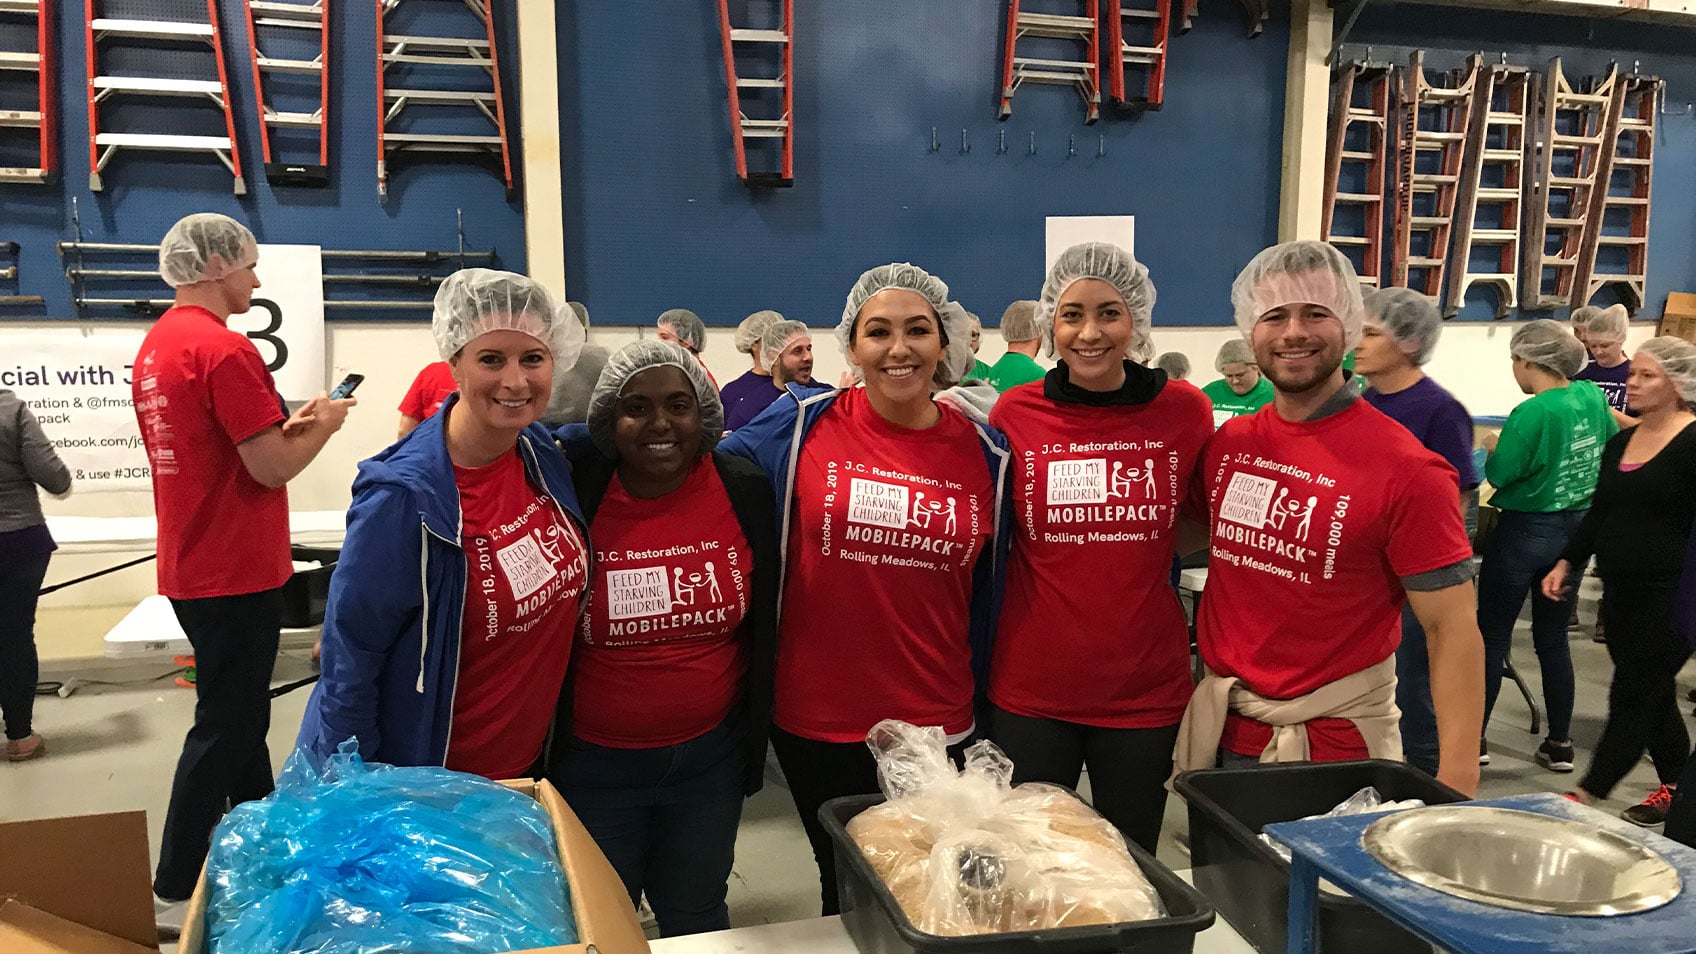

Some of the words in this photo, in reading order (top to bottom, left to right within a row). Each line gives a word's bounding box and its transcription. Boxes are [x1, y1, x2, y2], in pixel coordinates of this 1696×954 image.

[246, 297, 289, 372] 3
[57, 365, 115, 385] with
[73, 397, 83, 408] &
[38, 412, 71, 424] pack
[1041, 443, 1066, 455] J.C.
[1069, 440, 1141, 453] Restoration,
[1145, 440, 1164, 449] Inc
[76, 469, 85, 480] &
[89, 470, 110, 480] use
[114, 467, 150, 479] #JCR
[827, 460, 838, 488] 2019
[1025, 450, 1035, 477] 2019
[1053, 463, 1081, 477] FEED
[1086, 462, 1100, 474] MY
[1216, 454, 1230, 482] 2019
[1234, 452, 1250, 465] J.C.
[1253, 456, 1314, 483] Restoration,
[1316, 473, 1336, 488] Inc
[844, 461, 869, 473] J.C.
[872, 467, 943, 488] Restoration,
[945, 479, 963, 490] Inc
[1053, 475, 1100, 489] STARVING
[1232, 475, 1255, 492] FEED
[1255, 480, 1270, 496] MY
[536, 493, 550, 506] In
[824, 490, 838, 508] 18,
[856, 481, 884, 496] FEED
[888, 487, 902, 499] MY
[1052, 488, 1101, 501] CHILDREN
[1226, 490, 1265, 510] STARVING
[854, 494, 903, 512] STARVING
[1223, 503, 1262, 524] CHILDREN
[853, 506, 902, 525] CHILDREN
[968, 493, 979, 536] 109,000
[1025, 498, 1037, 541] October
[1047, 505, 1158, 524] MOBILEPACK
[1328, 494, 1351, 546] 109,000
[821, 511, 832, 556] October
[845, 525, 954, 556] MOBILEPACK
[1044, 532, 1084, 545] Rolling
[1088, 531, 1148, 542] Meadows,
[1216, 521, 1306, 563] MOBILEPACK
[476, 537, 492, 571] 2019
[501, 542, 529, 567] FEED
[597, 551, 623, 562] J.C.
[626, 544, 699, 561] Restoration,
[701, 539, 719, 550] Inc
[840, 549, 879, 566] Rolling
[881, 554, 938, 571] Meadows,
[940, 562, 951, 572] IL
[727, 545, 744, 592] 109,000
[1212, 545, 1240, 567] Rolling
[1241, 554, 1297, 581] Meadows,
[1300, 571, 1312, 585] IL
[1323, 548, 1337, 579] meals
[482, 574, 496, 595] 18,
[612, 572, 643, 588] FEED
[645, 570, 662, 585] MY
[613, 585, 664, 602] STARVING
[614, 598, 666, 616] CHILDREN
[609, 607, 727, 636] MOBILEPACK
